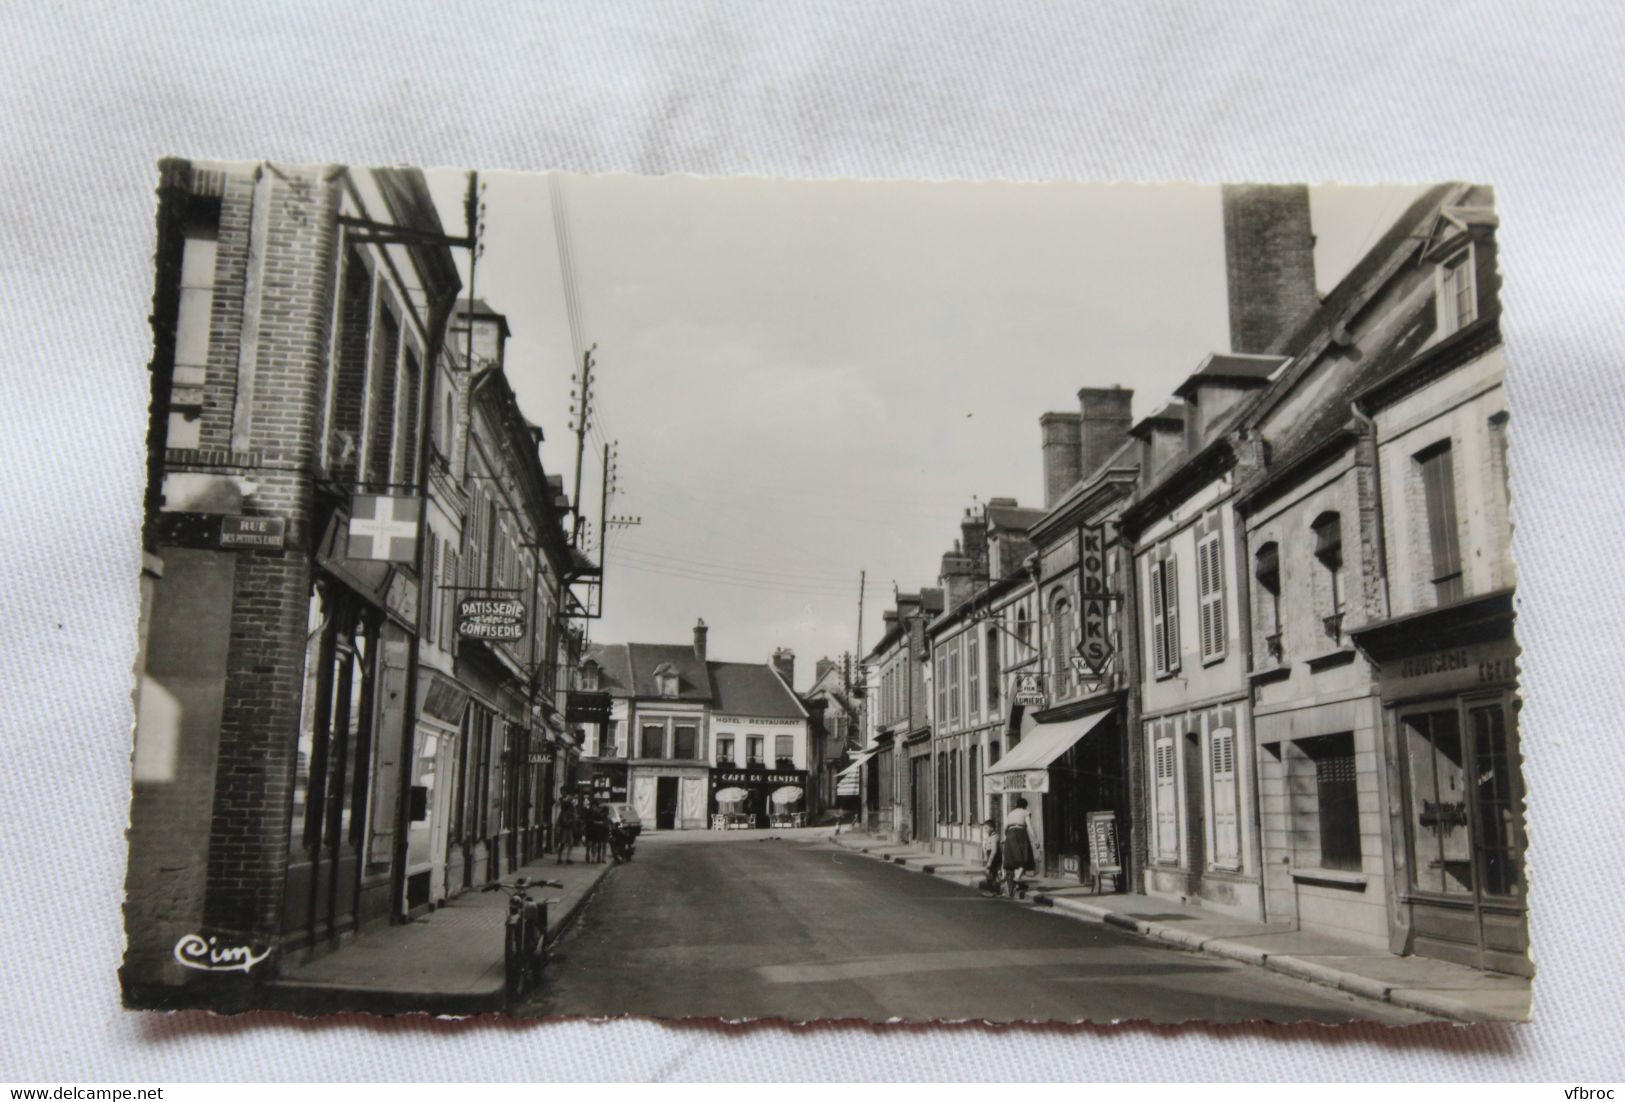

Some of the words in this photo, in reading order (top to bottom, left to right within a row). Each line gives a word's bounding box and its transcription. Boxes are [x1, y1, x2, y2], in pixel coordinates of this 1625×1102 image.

[240, 521, 267, 532] RUE
[1084, 535, 1104, 659] KODAKS
[462, 602, 522, 618] PATISSERIE
[460, 622, 523, 637] CONFISERIE
[528, 754, 552, 763] TABAC
